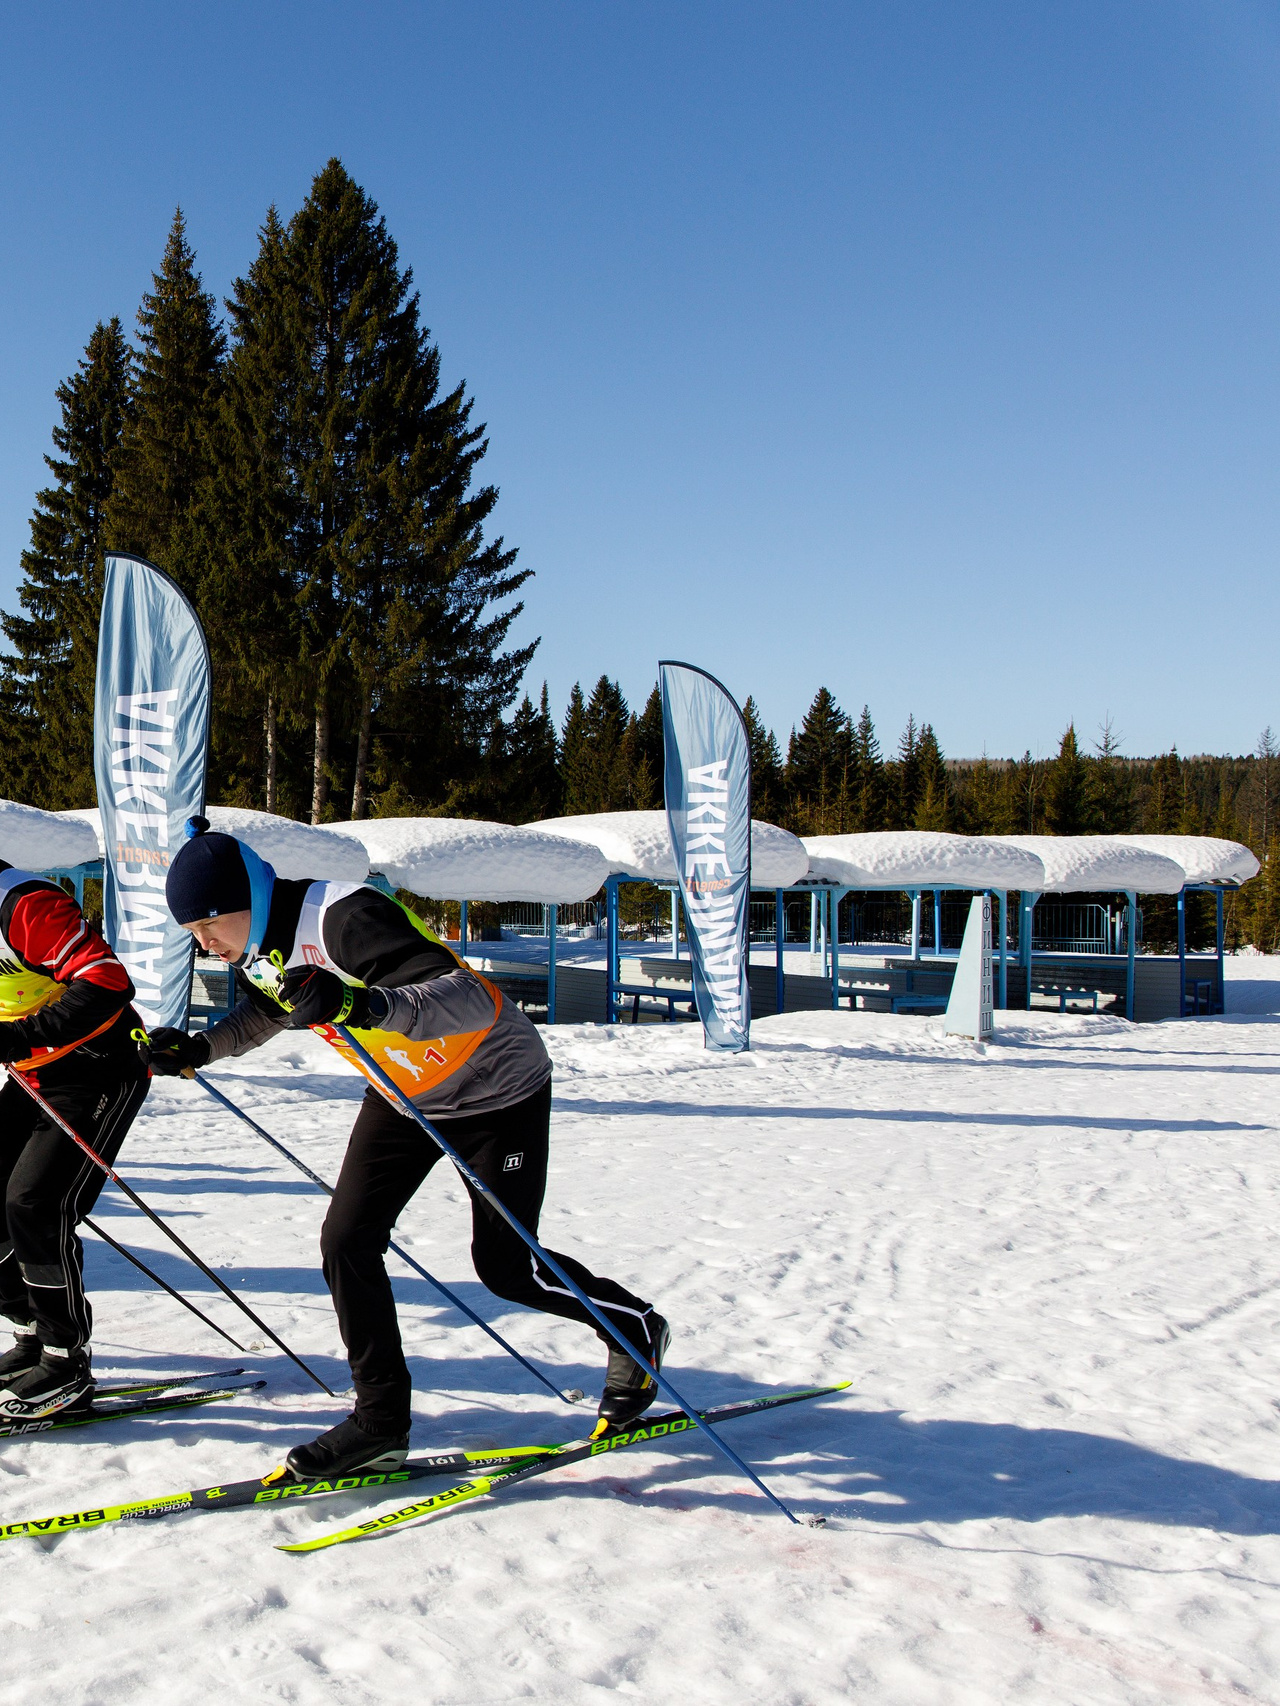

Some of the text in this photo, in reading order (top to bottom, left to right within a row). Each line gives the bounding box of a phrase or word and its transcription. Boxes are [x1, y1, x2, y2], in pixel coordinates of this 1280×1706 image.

[982, 902, 992, 1033] ФИНИШ
[424, 1047, 447, 1066] 1
[590, 1415, 706, 1456] BRADOS
[254, 1471, 412, 1503] BRADOS
[357, 1481, 477, 1532] BRADOS
